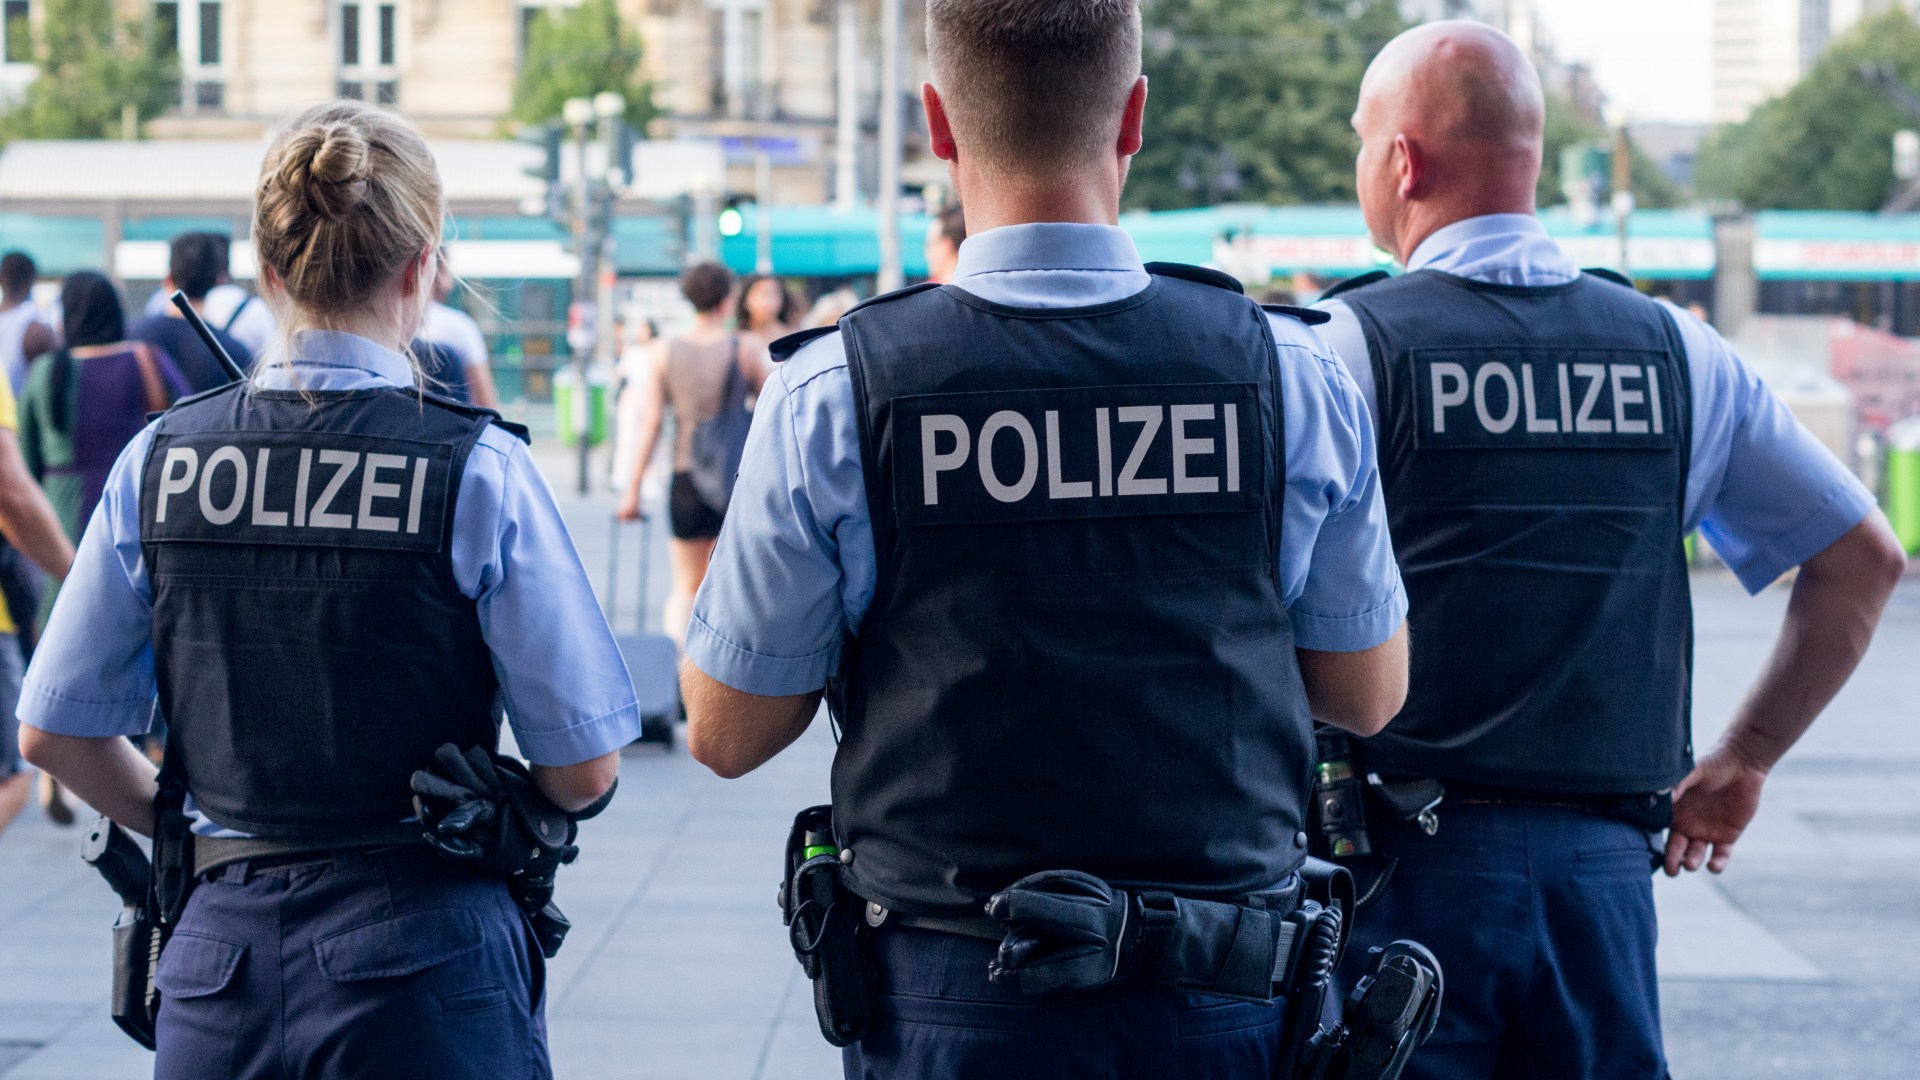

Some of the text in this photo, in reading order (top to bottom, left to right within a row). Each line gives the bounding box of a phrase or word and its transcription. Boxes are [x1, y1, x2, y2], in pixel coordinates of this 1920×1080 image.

[1430, 362, 1663, 434] POLIZEI
[155, 445, 429, 534] POLIZEI
[920, 403, 1240, 505] POLIZEI
